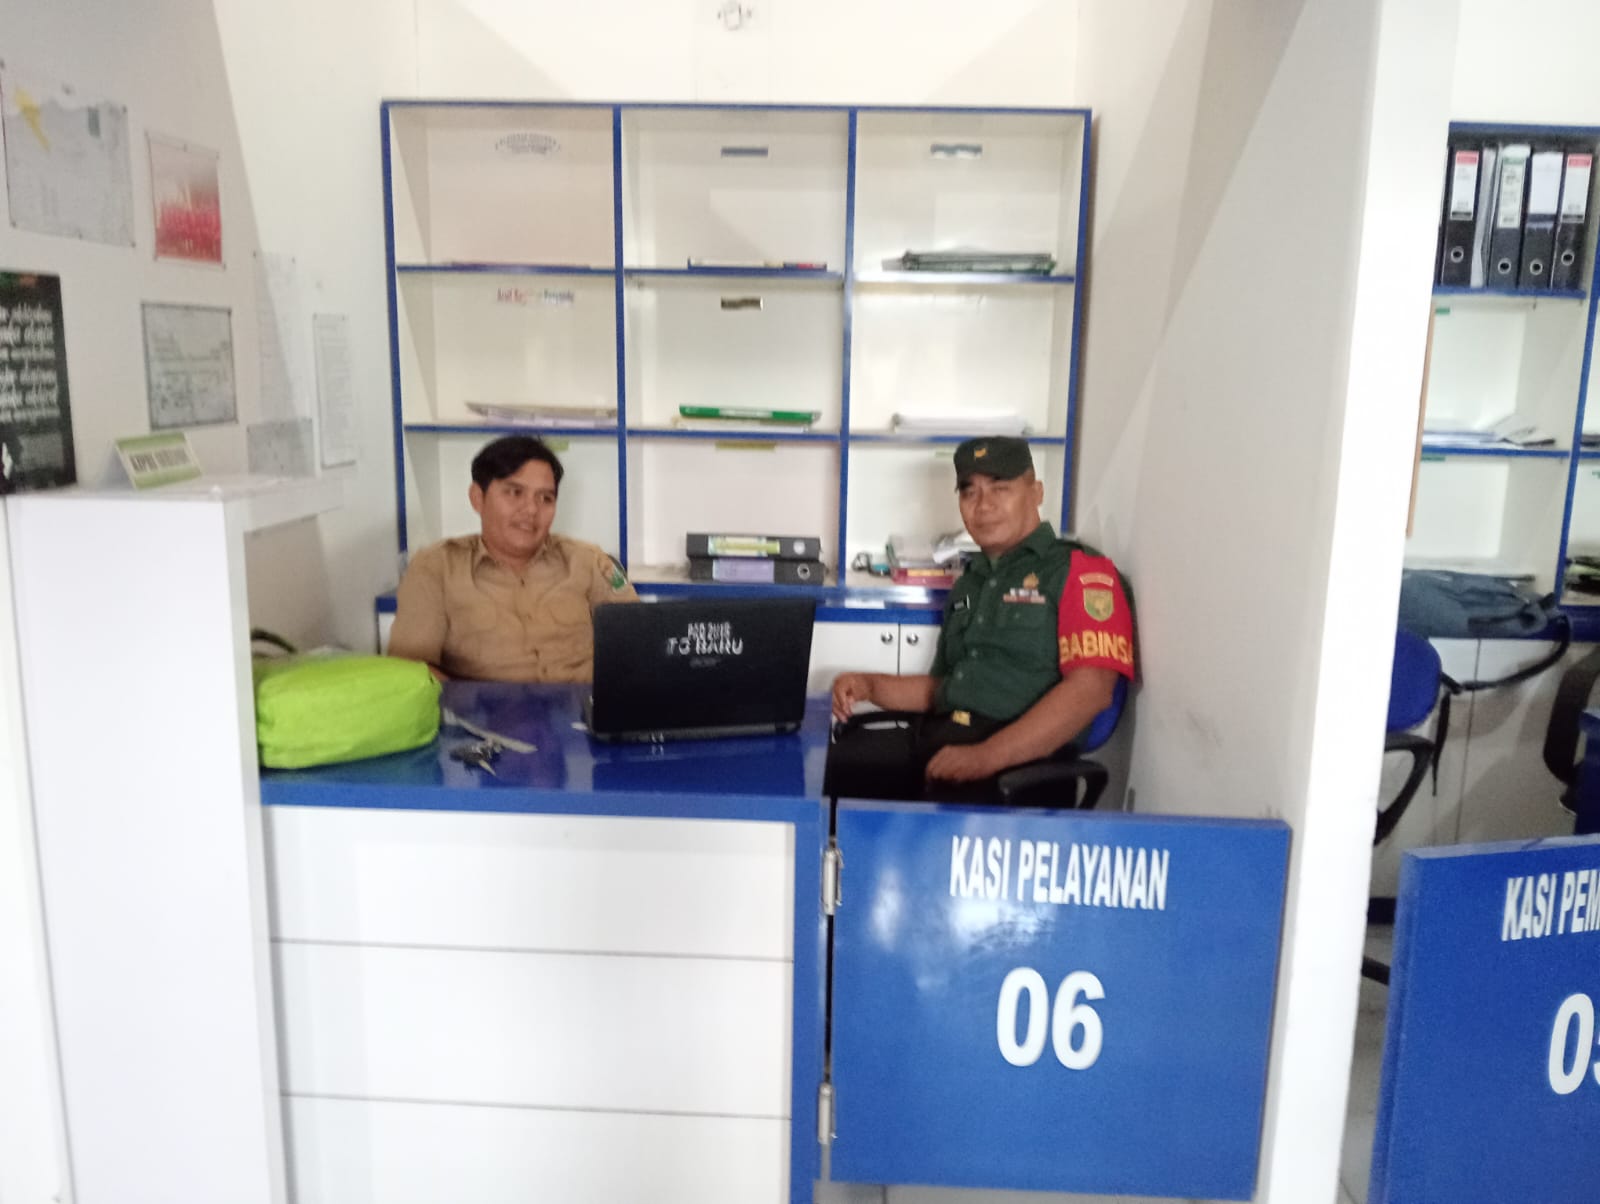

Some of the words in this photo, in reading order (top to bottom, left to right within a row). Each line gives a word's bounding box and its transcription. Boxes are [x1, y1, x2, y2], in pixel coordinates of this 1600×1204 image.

[950, 835, 1011, 901] KASI
[1017, 839, 1170, 910] PELAYANAN
[1501, 873, 1557, 942] KASI
[997, 966, 1105, 1070] 06
[1548, 993, 1600, 1095] 0
